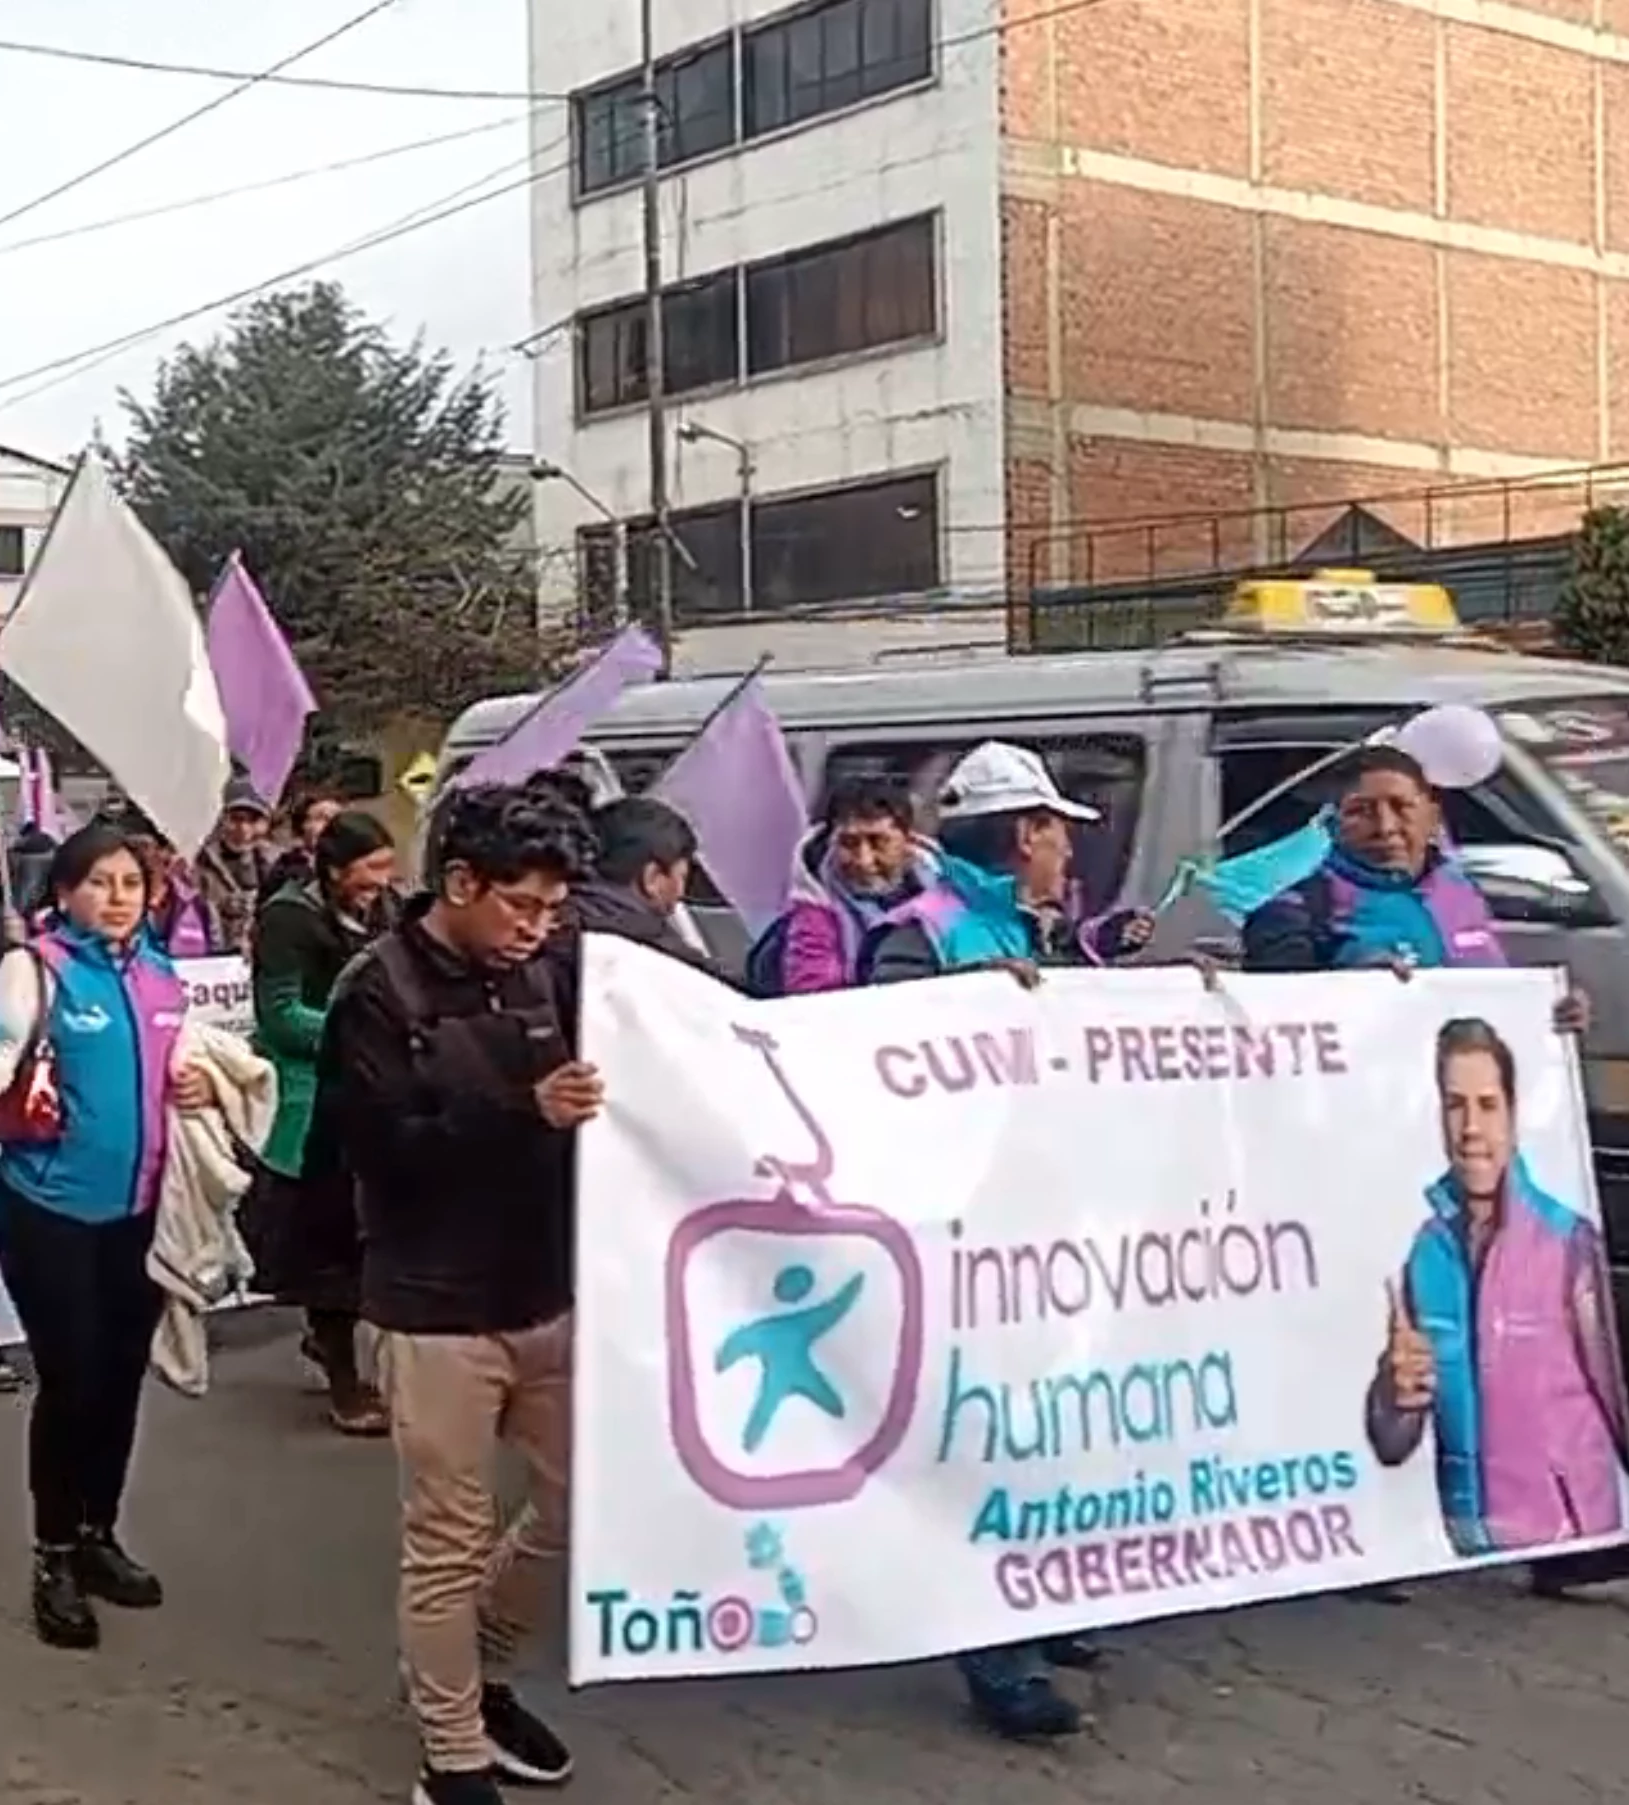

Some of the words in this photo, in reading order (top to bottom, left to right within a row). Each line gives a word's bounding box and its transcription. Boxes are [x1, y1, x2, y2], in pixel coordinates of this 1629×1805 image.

[873, 1027, 1040, 1099] CUMI
[1085, 1022, 1348, 1083] PRESENTE
[947, 1189, 1319, 1329] innovación
[936, 1346, 1238, 1462] humana
[970, 1471, 1174, 1545] Antonio
[1190, 1450, 1359, 1516] Riveros
[995, 1504, 1365, 1611] GOBERNADOR
